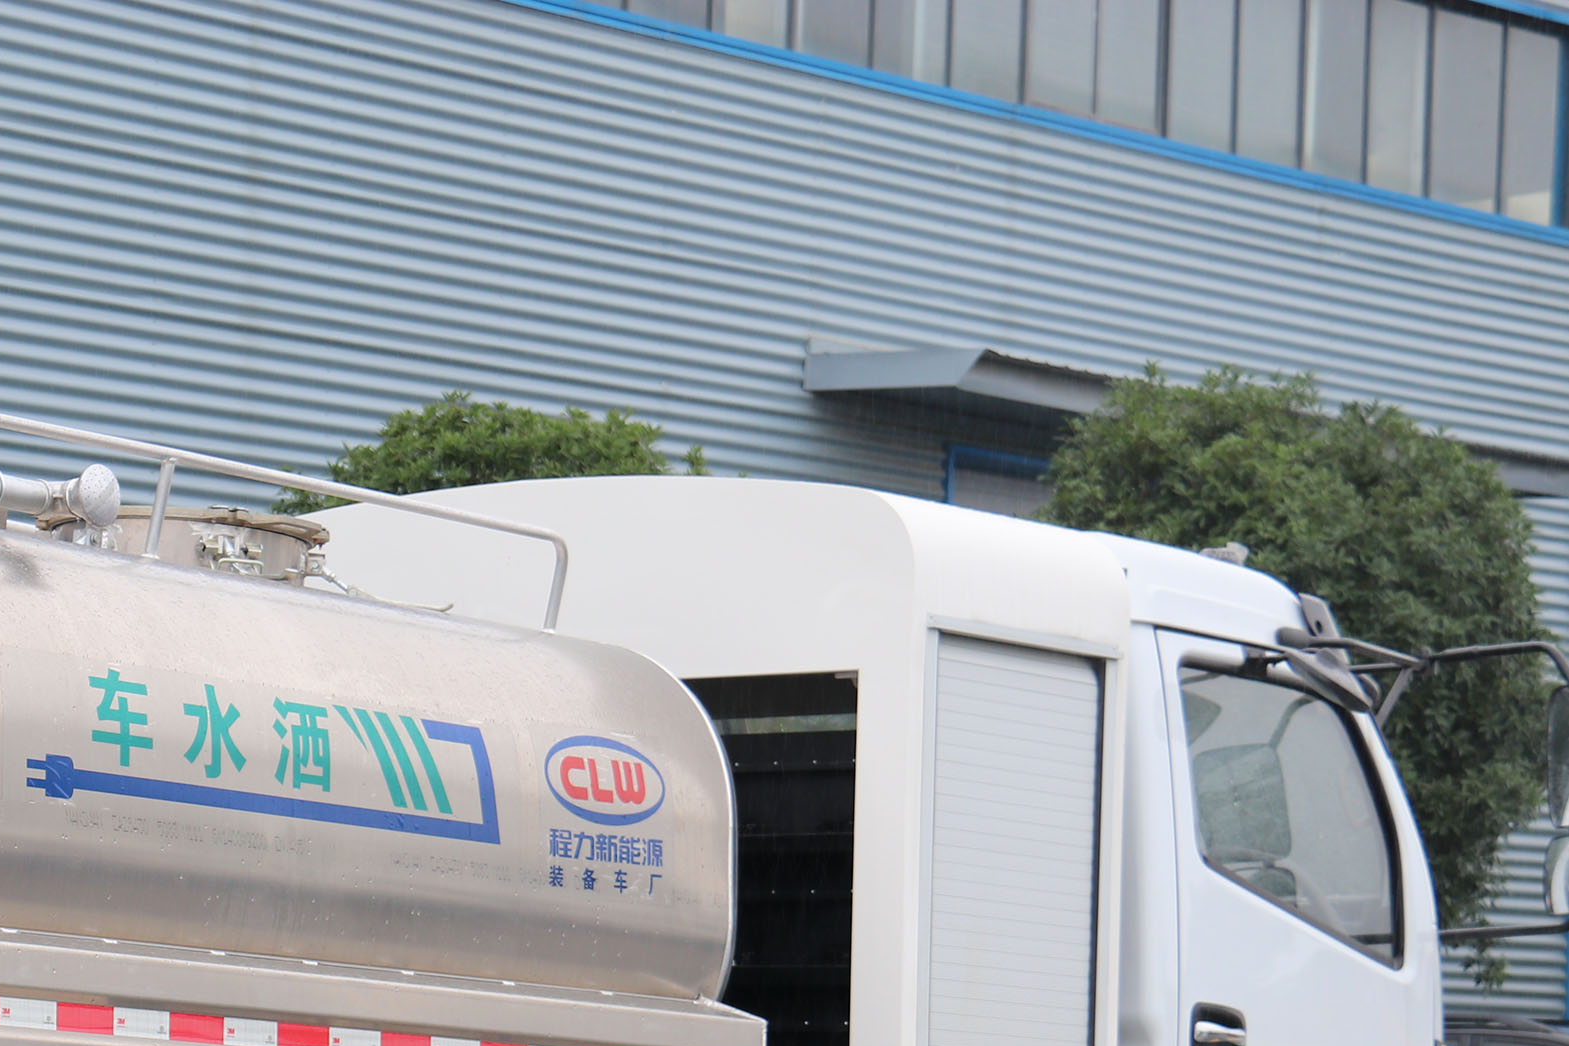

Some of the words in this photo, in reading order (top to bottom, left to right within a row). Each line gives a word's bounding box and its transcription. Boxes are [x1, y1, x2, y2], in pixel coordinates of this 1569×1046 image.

[560, 755, 646, 805] CLW
[549, 828, 663, 867] 程力新能源
[549, 865, 662, 895] 装备车厂
